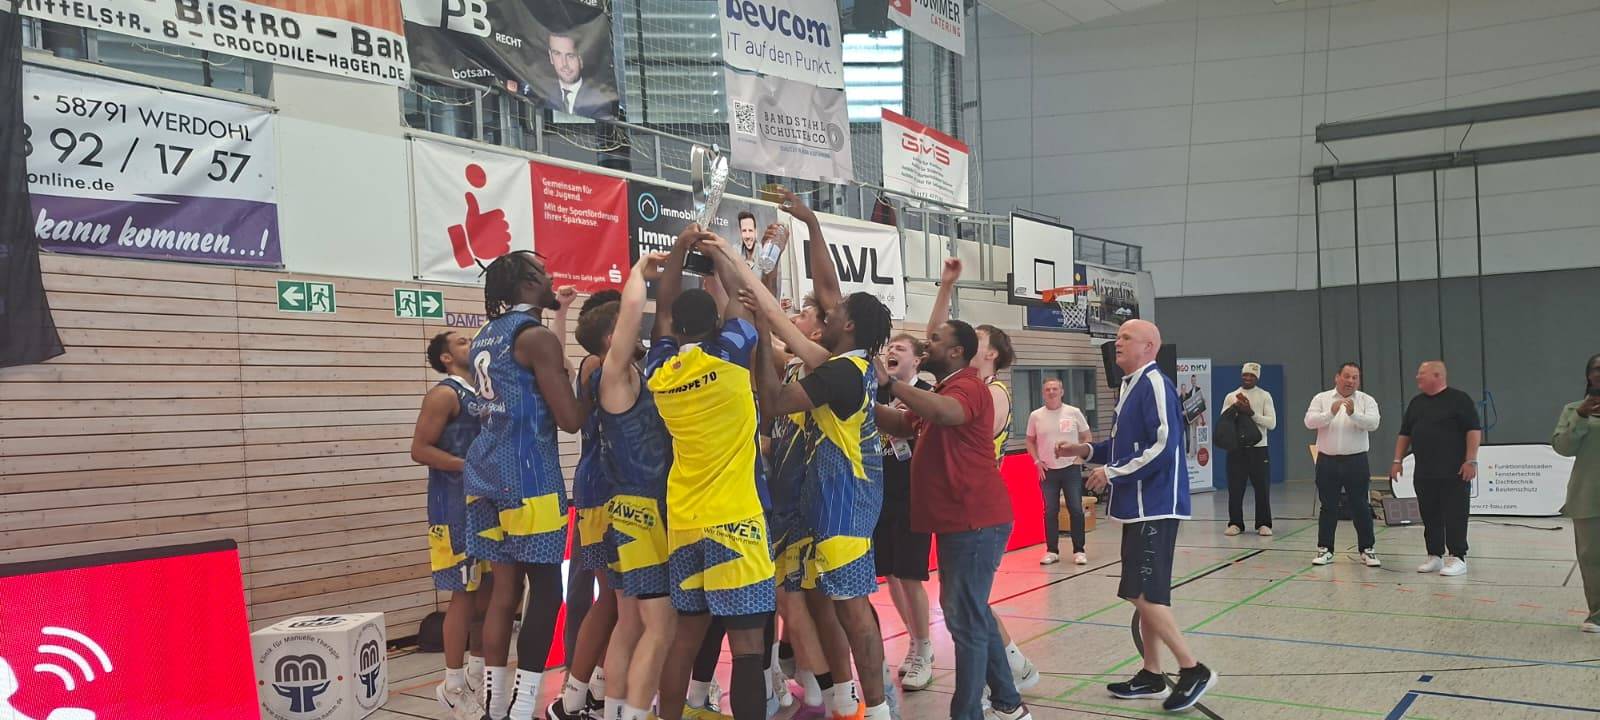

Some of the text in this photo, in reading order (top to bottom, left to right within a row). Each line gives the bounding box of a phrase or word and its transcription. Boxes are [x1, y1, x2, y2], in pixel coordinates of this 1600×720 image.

[163, 20, 179, 38] 8
[930, 13, 961, 38] CATERING
[495, 32, 523, 48] RECHT
[726, 31, 837, 75] IT auf den Punkt.
[55, 94, 254, 143] 58791 WERDOHL
[764, 111, 826, 132] BANDSTAHL
[50, 127, 104, 169] 92
[153, 143, 194, 177] 17
[207, 150, 251, 184] 57
[542, 177, 593, 195] Gemeinsam für
[543, 187, 554, 197] die
[544, 202, 556, 212] Mit
[557, 205, 569, 214] der
[35, 207, 112, 245] kann
[445, 312, 485, 329] DAME
[701, 371, 717, 385] 70
